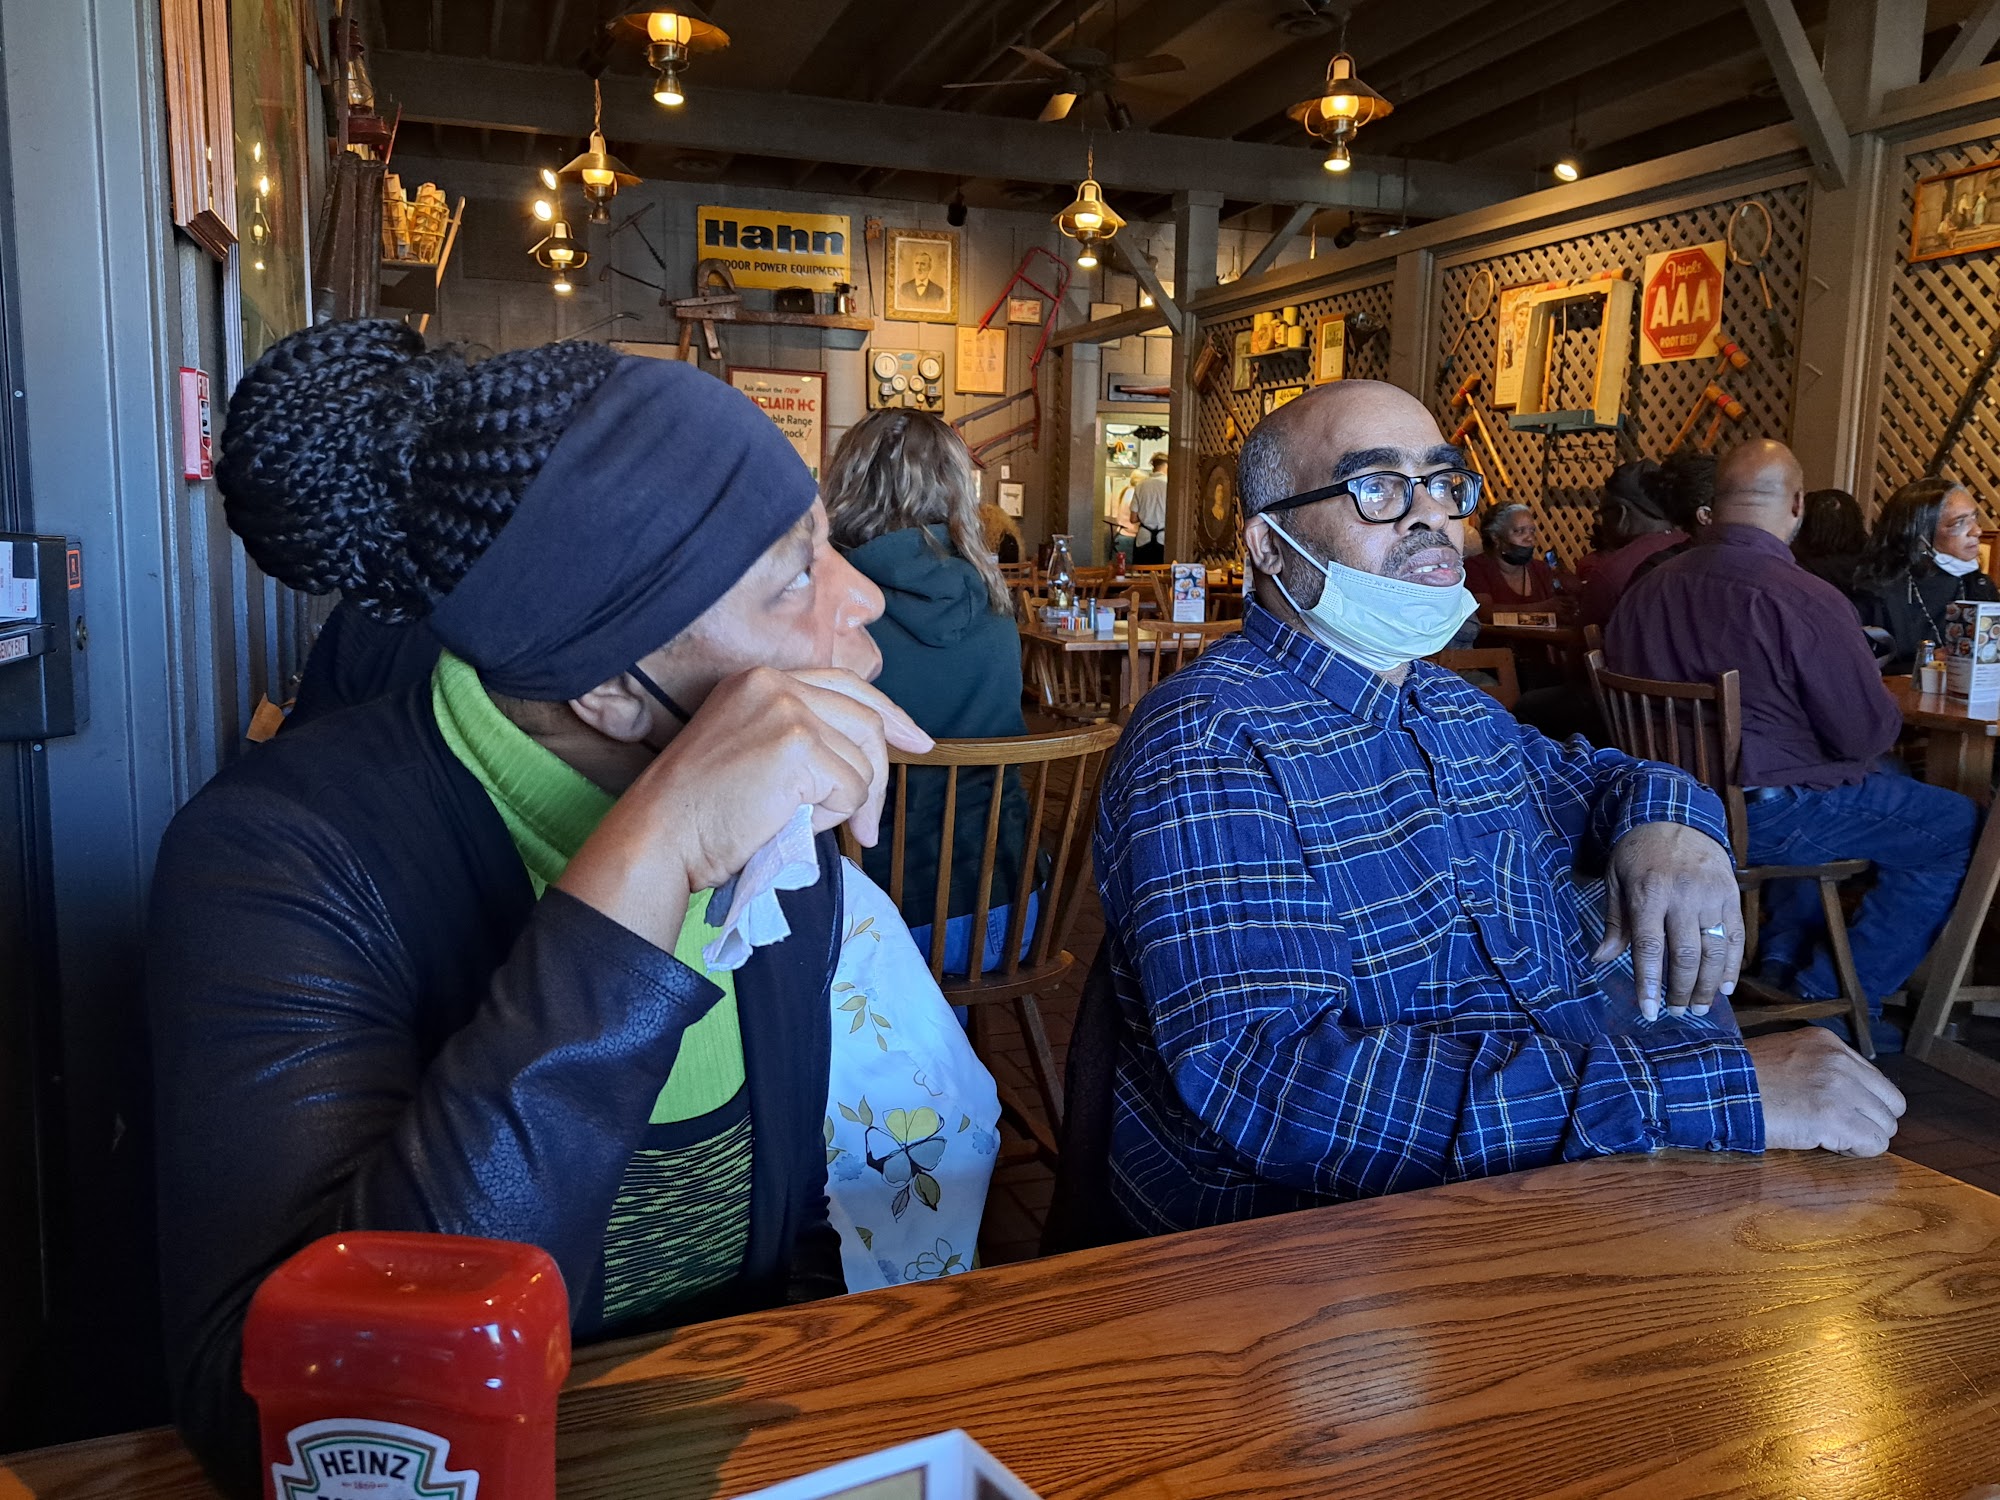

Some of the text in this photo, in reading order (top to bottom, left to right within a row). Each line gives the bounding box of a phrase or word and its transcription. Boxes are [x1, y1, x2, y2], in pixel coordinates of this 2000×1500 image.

[705, 219, 844, 255] Hahn
[721, 259, 844, 277] DOOR POWER EQUIPMENT
[1666, 260, 1701, 290] Triple
[1660, 333, 1698, 348] ROOT BEER
[744, 384, 754, 392] Ask
[747, 395, 795, 411] NCLAIR
[770, 414, 813, 428] ble Range
[781, 428, 812, 441] nock!
[318, 1449, 410, 1480] HEINZ
